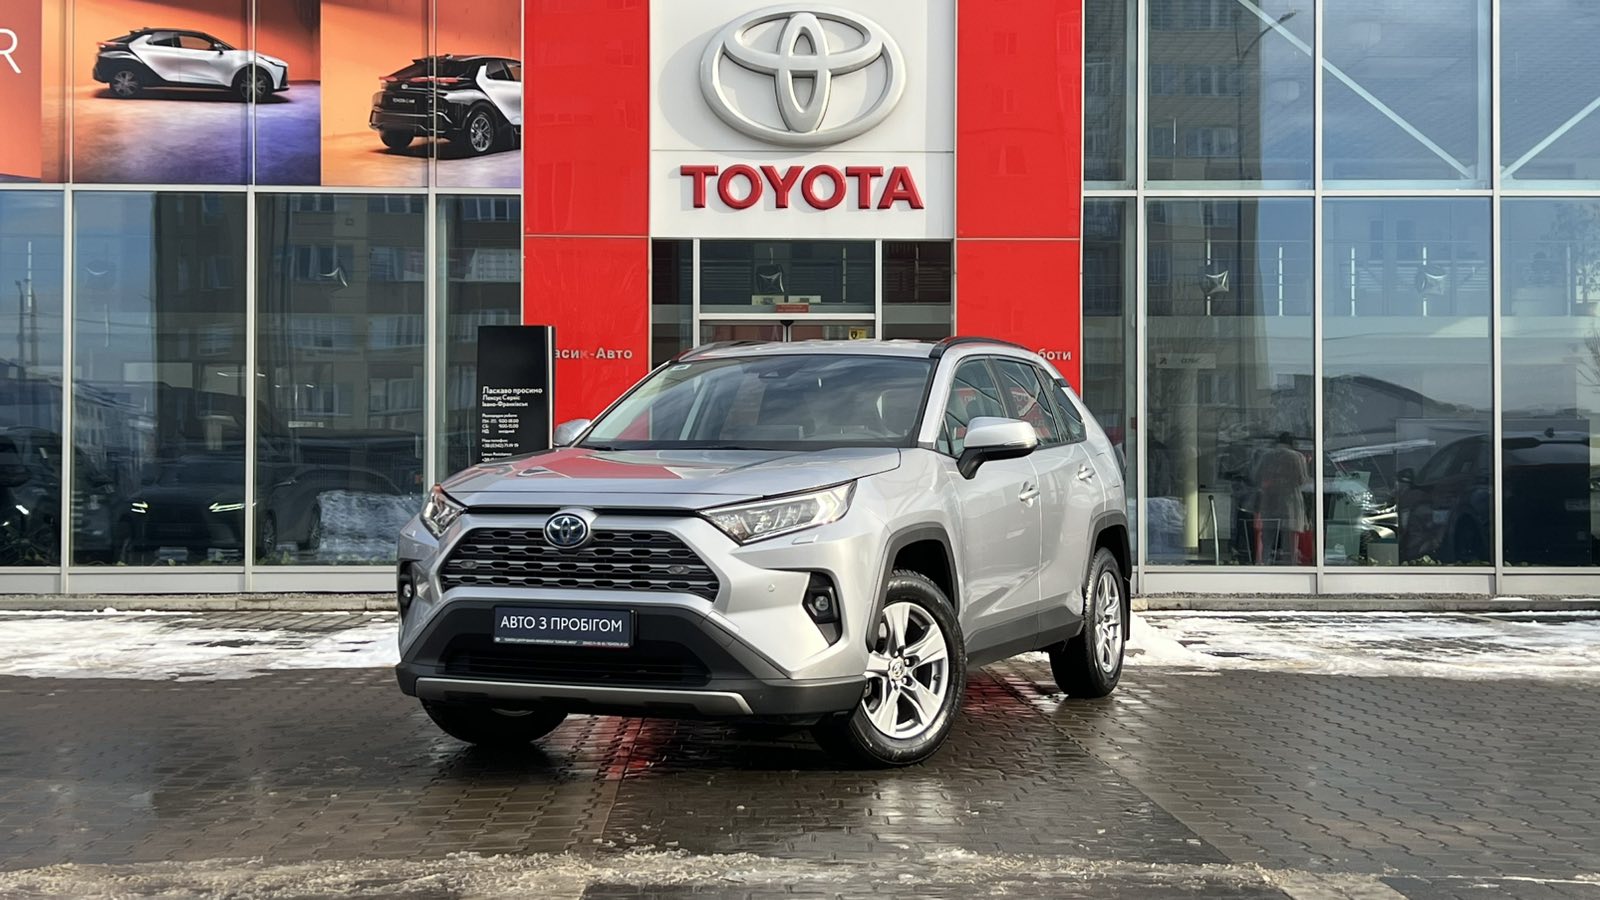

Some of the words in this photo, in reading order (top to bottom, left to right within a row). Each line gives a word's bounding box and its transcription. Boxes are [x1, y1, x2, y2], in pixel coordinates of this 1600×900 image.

[680, 164, 925, 210] TOYOTA
[482, 386, 512, 394] Ласкаво
[500, 616, 536, 629] АВТО
[550, 617, 623, 632] ПРОБІГОМ
